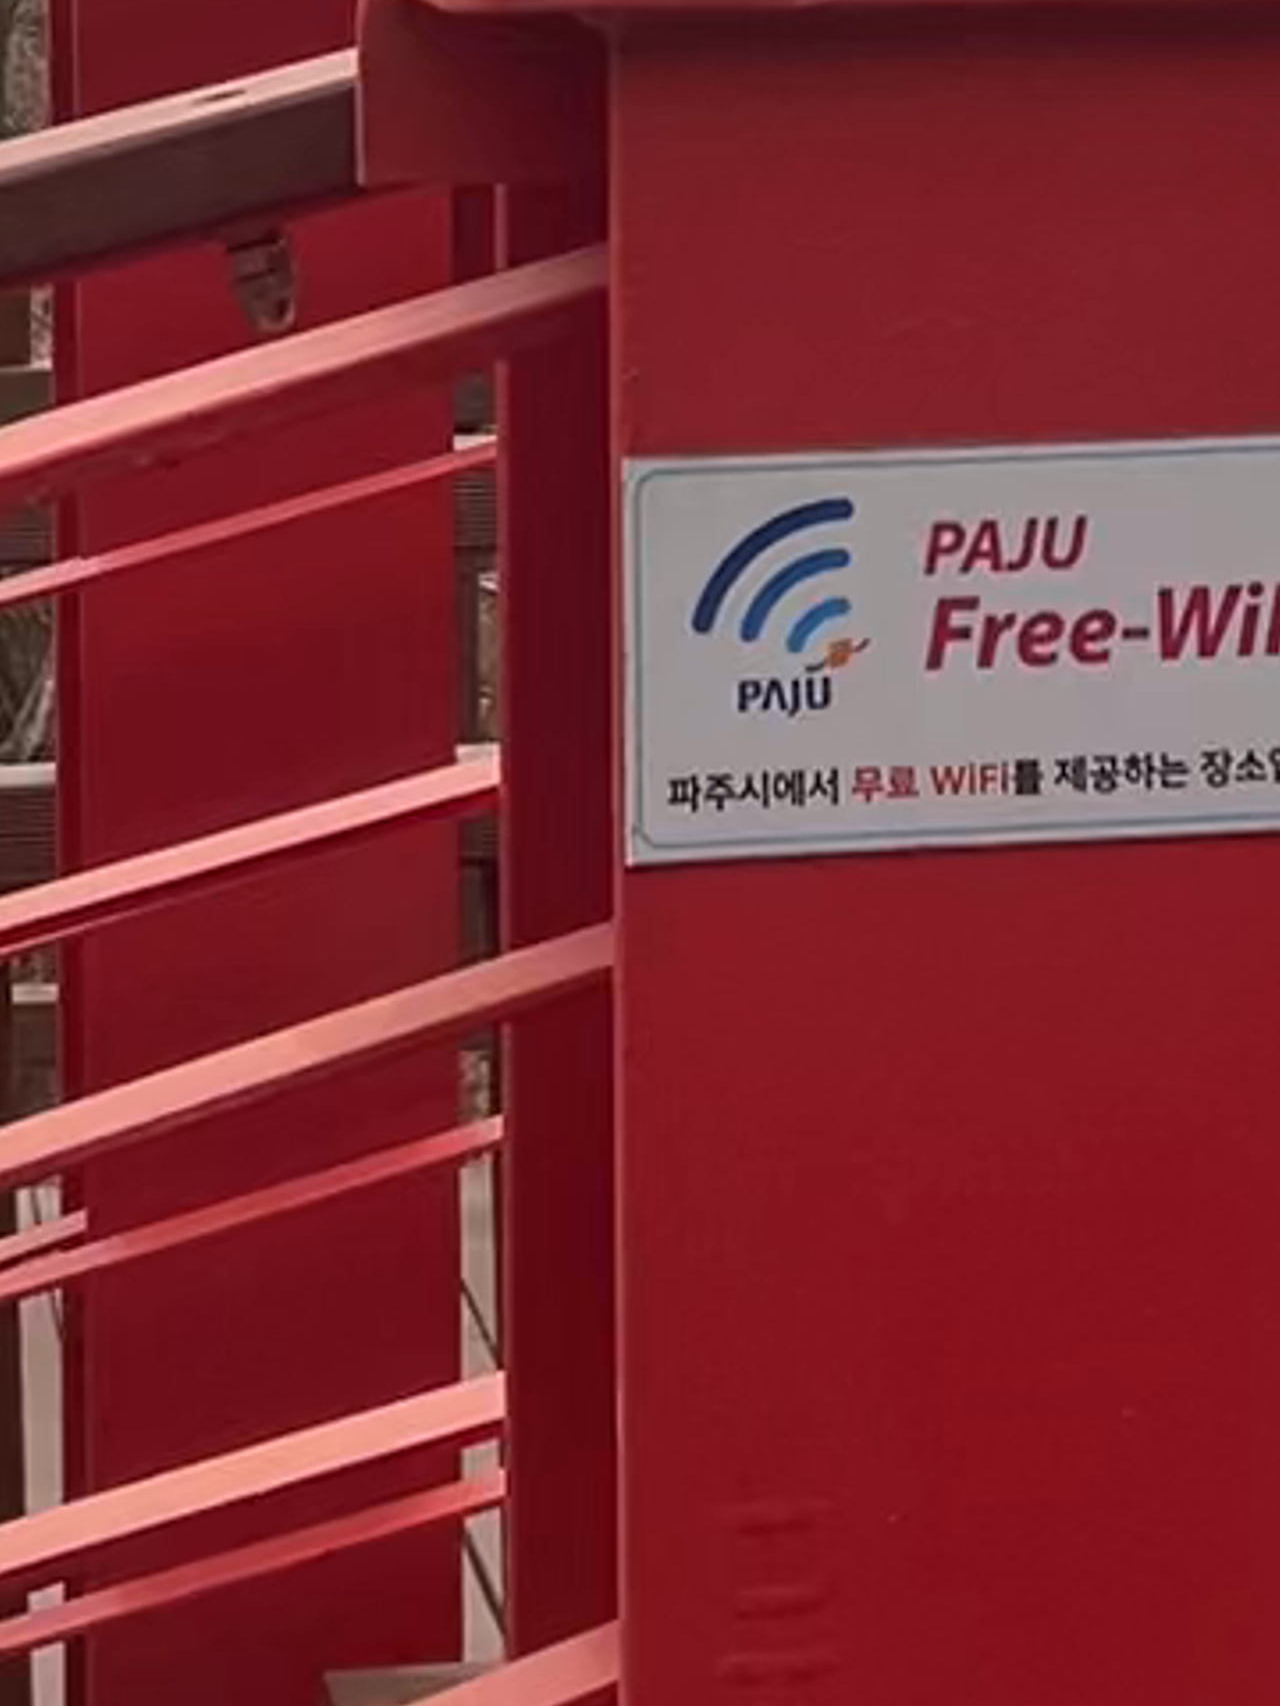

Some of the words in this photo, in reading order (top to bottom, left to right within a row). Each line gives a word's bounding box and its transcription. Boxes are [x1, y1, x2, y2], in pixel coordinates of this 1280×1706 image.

[923, 515, 1088, 576] PAJU
[736, 675, 833, 717] PAJU
[667, 767, 840, 813] 파주시에서
[851, 765, 920, 802] 무료
[929, 759, 1044, 797] WiFi를
[1052, 751, 1192, 794] 제공하는
